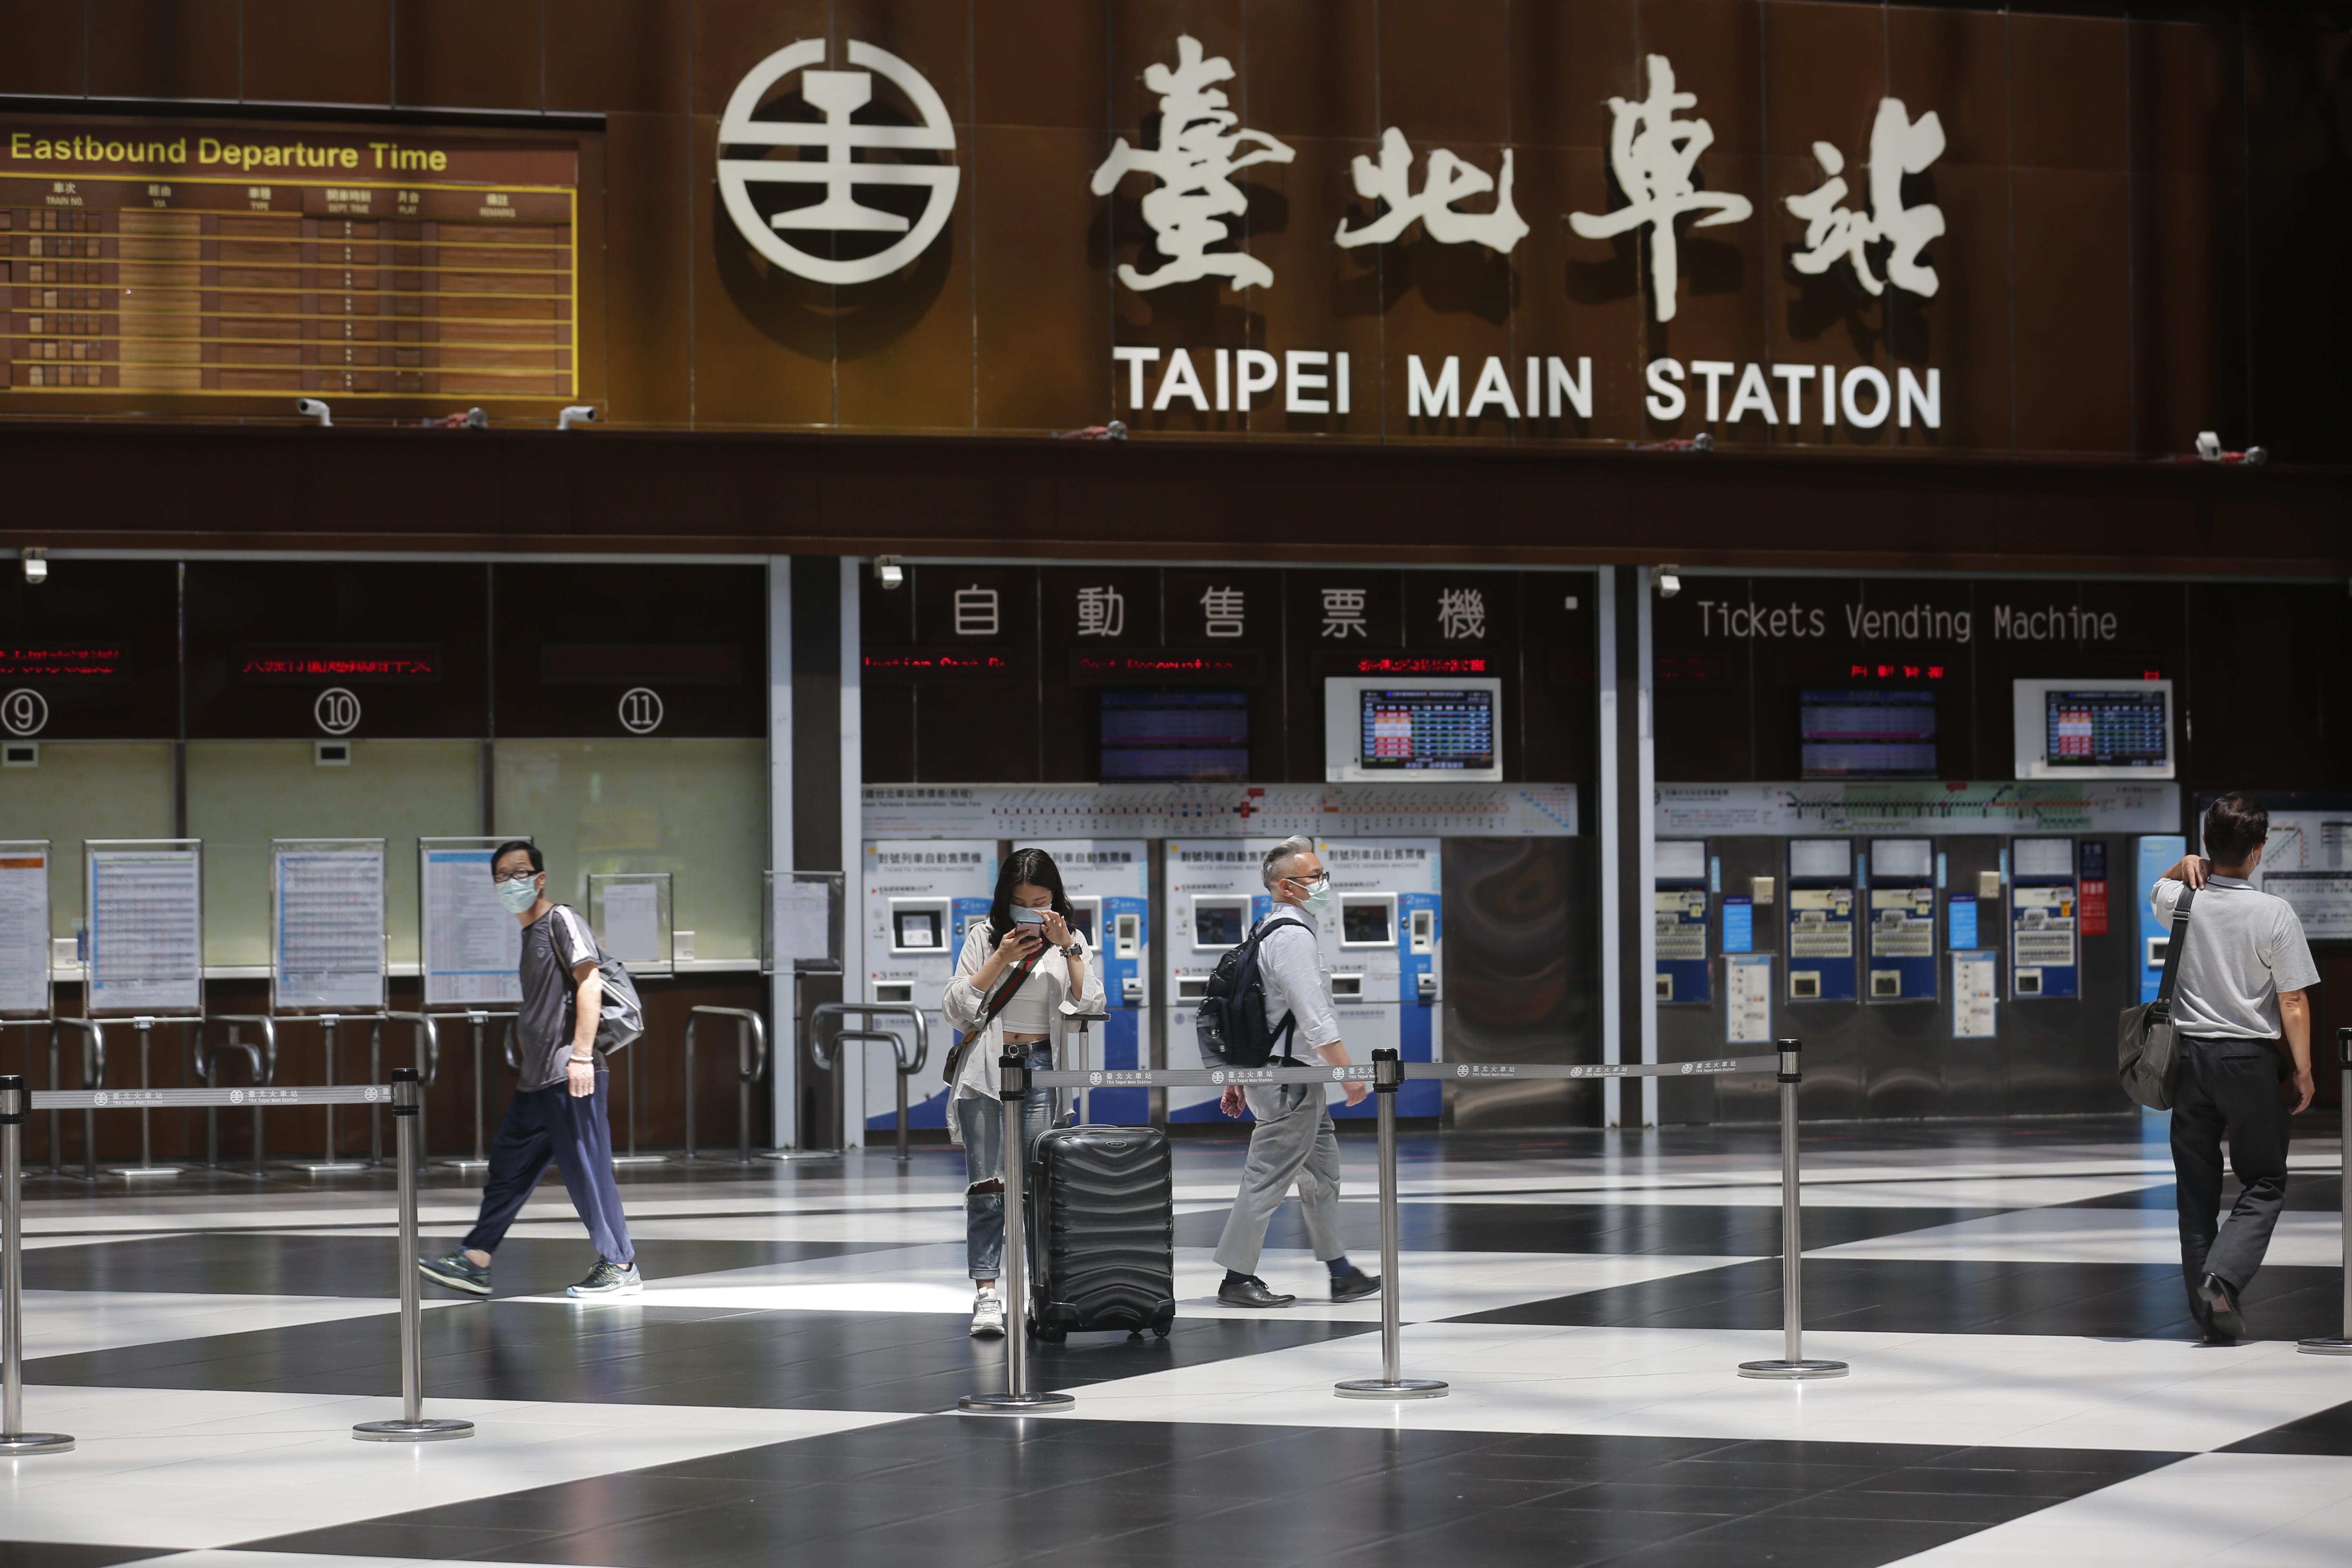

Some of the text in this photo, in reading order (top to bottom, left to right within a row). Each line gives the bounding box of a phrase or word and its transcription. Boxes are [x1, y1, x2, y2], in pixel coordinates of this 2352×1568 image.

[11, 133, 448, 172] Eastbound Departure Time
[1090, 34, 1946, 322] 臺北車站
[46, 196, 69, 205] TRAIN
[1113, 346, 1941, 428] TAIPEI MAIN STATION
[954, 584, 1486, 639] 自動售票機
[1698, 601, 2117, 643] Tickets Vending Machine
[14, 694, 33, 729] 9
[326, 696, 354, 726] 10
[629, 695, 653, 725] 11
[878, 852, 982, 864] 對號列車自動售票機
[960, 900, 969, 910] 2
[1111, 898, 1120, 909] 2
[1261, 897, 1269, 907] 2
[1407, 895, 1415, 904] 2
[1696, 1060, 1737, 1069] 臺北火車站
[1228, 1070, 1273, 1078] 臺北火車站
[112, 1091, 163, 1100] 臺北火車站
[248, 1089, 298, 1098] 臺北火車站
